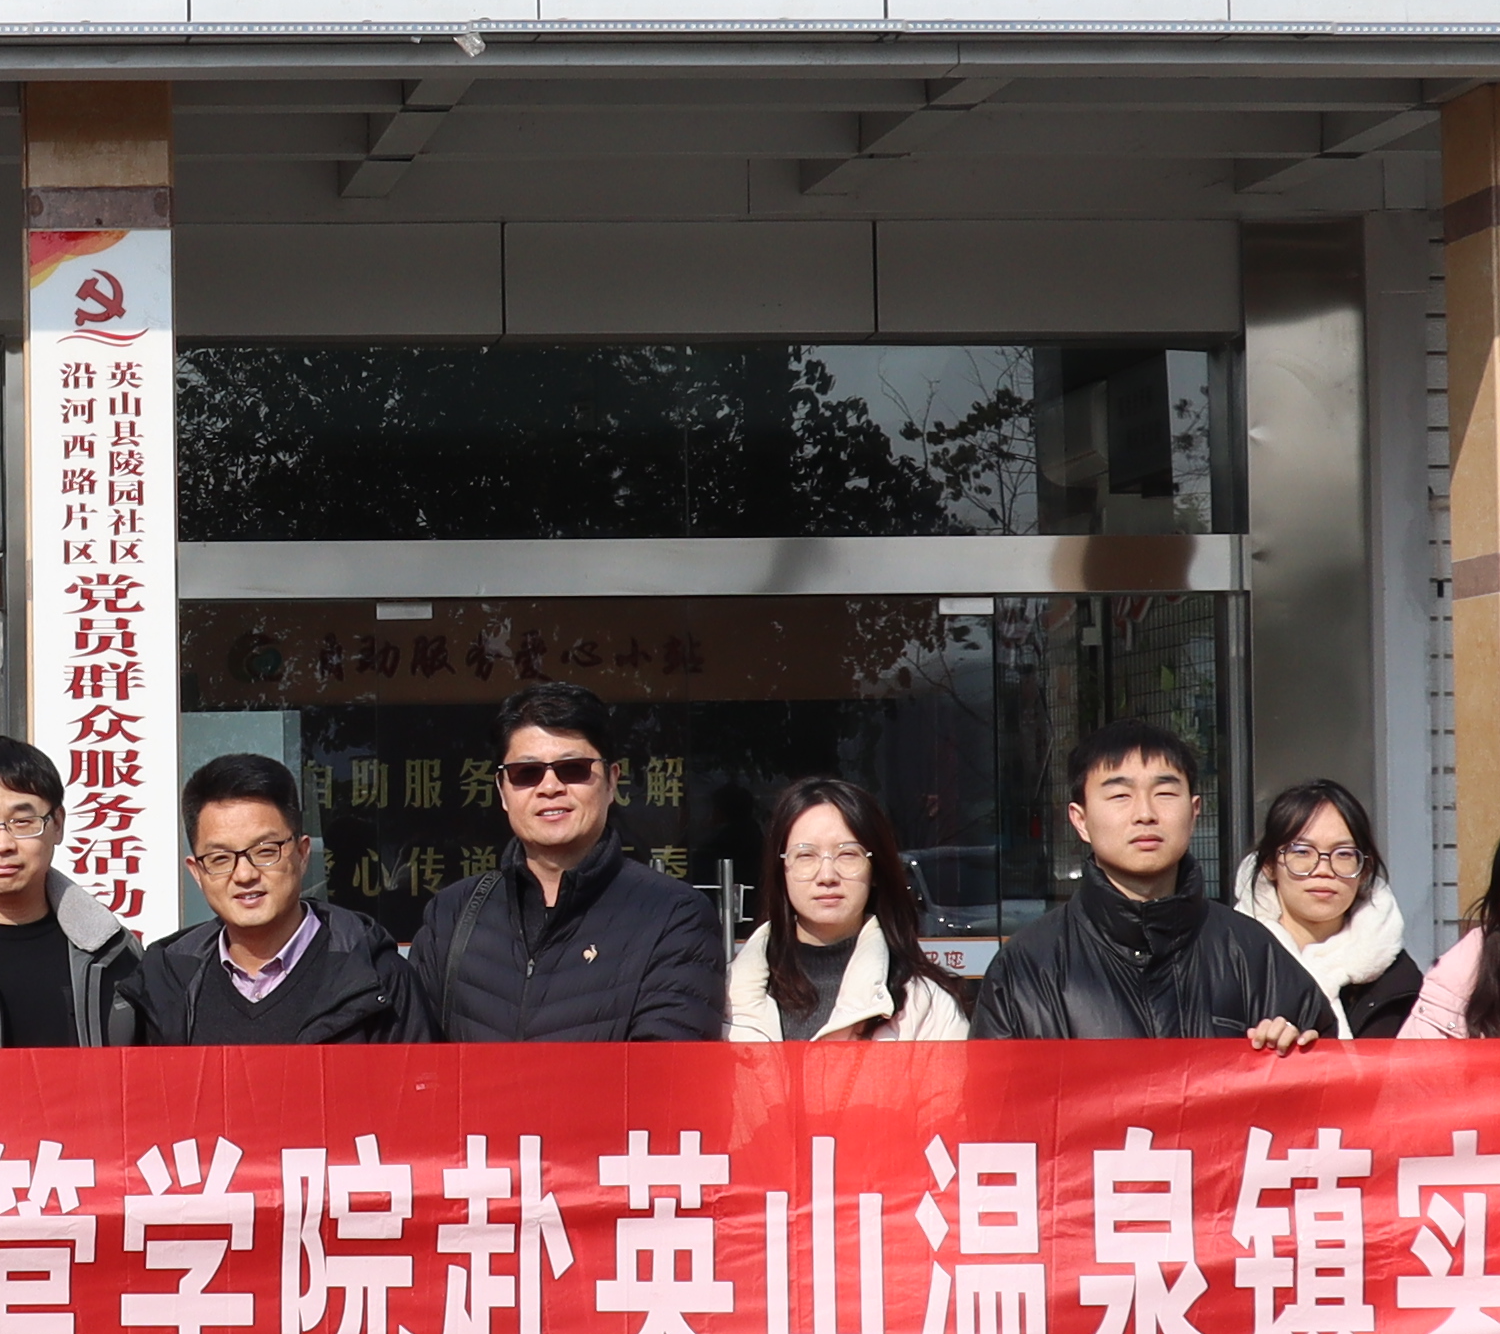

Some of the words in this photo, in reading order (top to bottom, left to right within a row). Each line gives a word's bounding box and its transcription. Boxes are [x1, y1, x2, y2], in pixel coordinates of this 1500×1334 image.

[59, 360, 98, 566] 沿河西路片区
[106, 360, 146, 566] 英山县陵园社区
[63, 573, 147, 942] 党员群众服务活动
